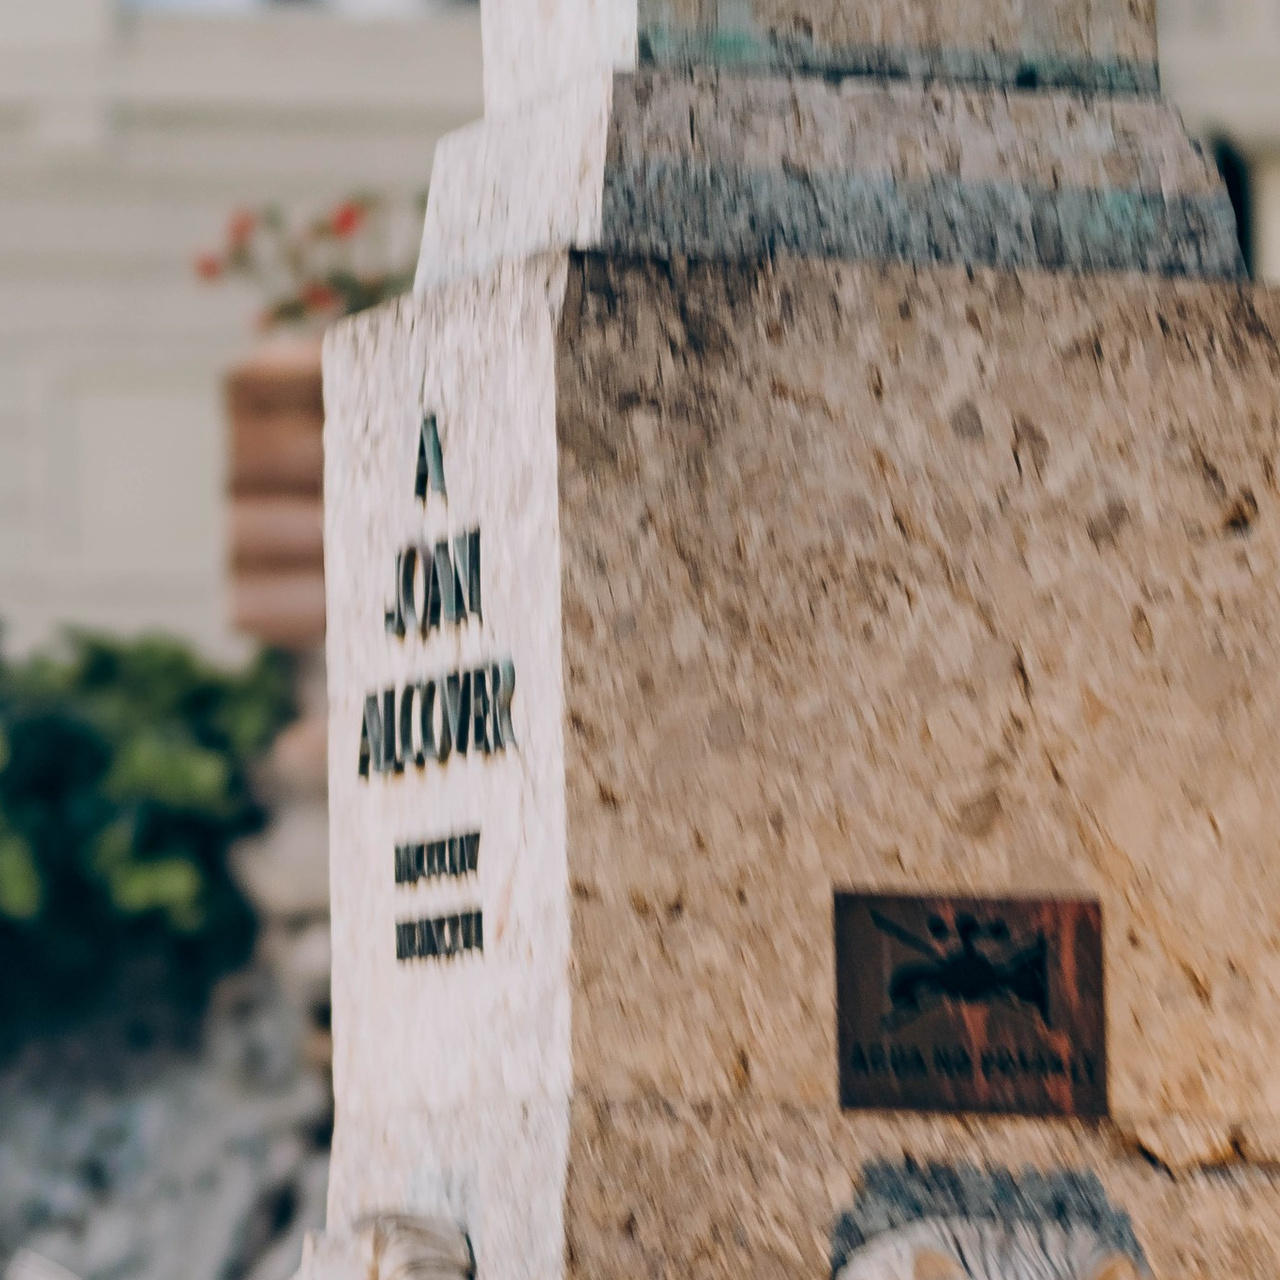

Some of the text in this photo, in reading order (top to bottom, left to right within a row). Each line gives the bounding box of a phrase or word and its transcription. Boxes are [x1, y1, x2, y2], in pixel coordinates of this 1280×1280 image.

[414, 413, 448, 502] A
[385, 526, 482, 640] JOAN
[358, 658, 518, 778] ALCOVER
